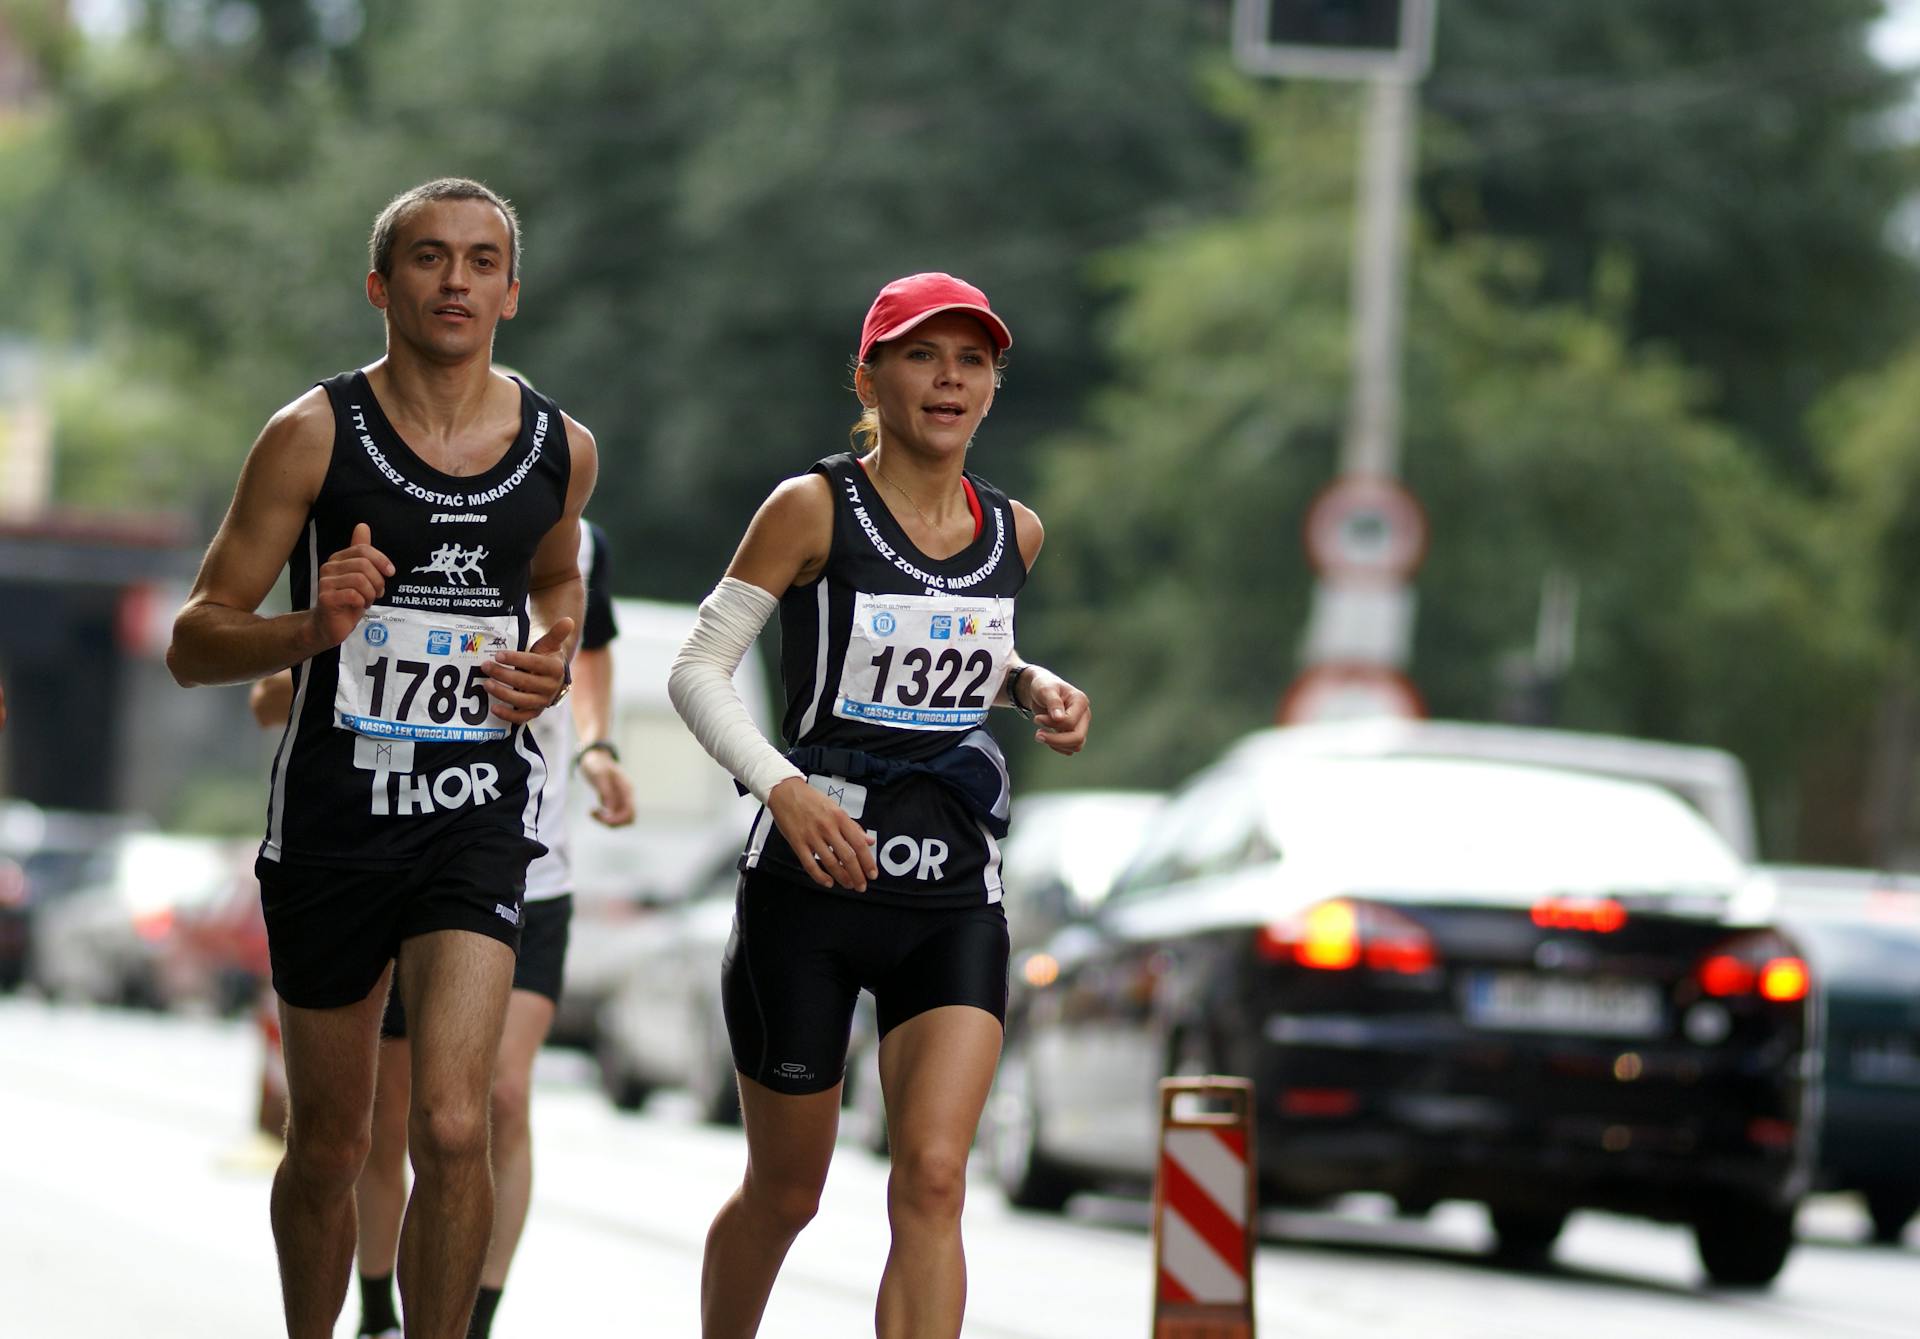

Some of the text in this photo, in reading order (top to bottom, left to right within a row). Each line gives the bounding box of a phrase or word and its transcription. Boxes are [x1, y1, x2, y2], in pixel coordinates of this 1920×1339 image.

[353, 412, 368, 432] TY
[360, 434, 406, 486] MOŻESZ
[468, 410, 549, 507] MARATOŃCZYKIEM
[404, 481, 464, 507] ZOSTAĆ
[846, 485, 862, 504] TY
[854, 506, 897, 561] MOŻESZ
[894, 556, 945, 588] ZOSTAĆ
[392, 595, 450, 607] MARATON
[365, 656, 489, 725] 1785
[871, 646, 992, 708] 1322
[864, 706, 914, 721] HASCO-LEK
[353, 735, 502, 816] THOR
